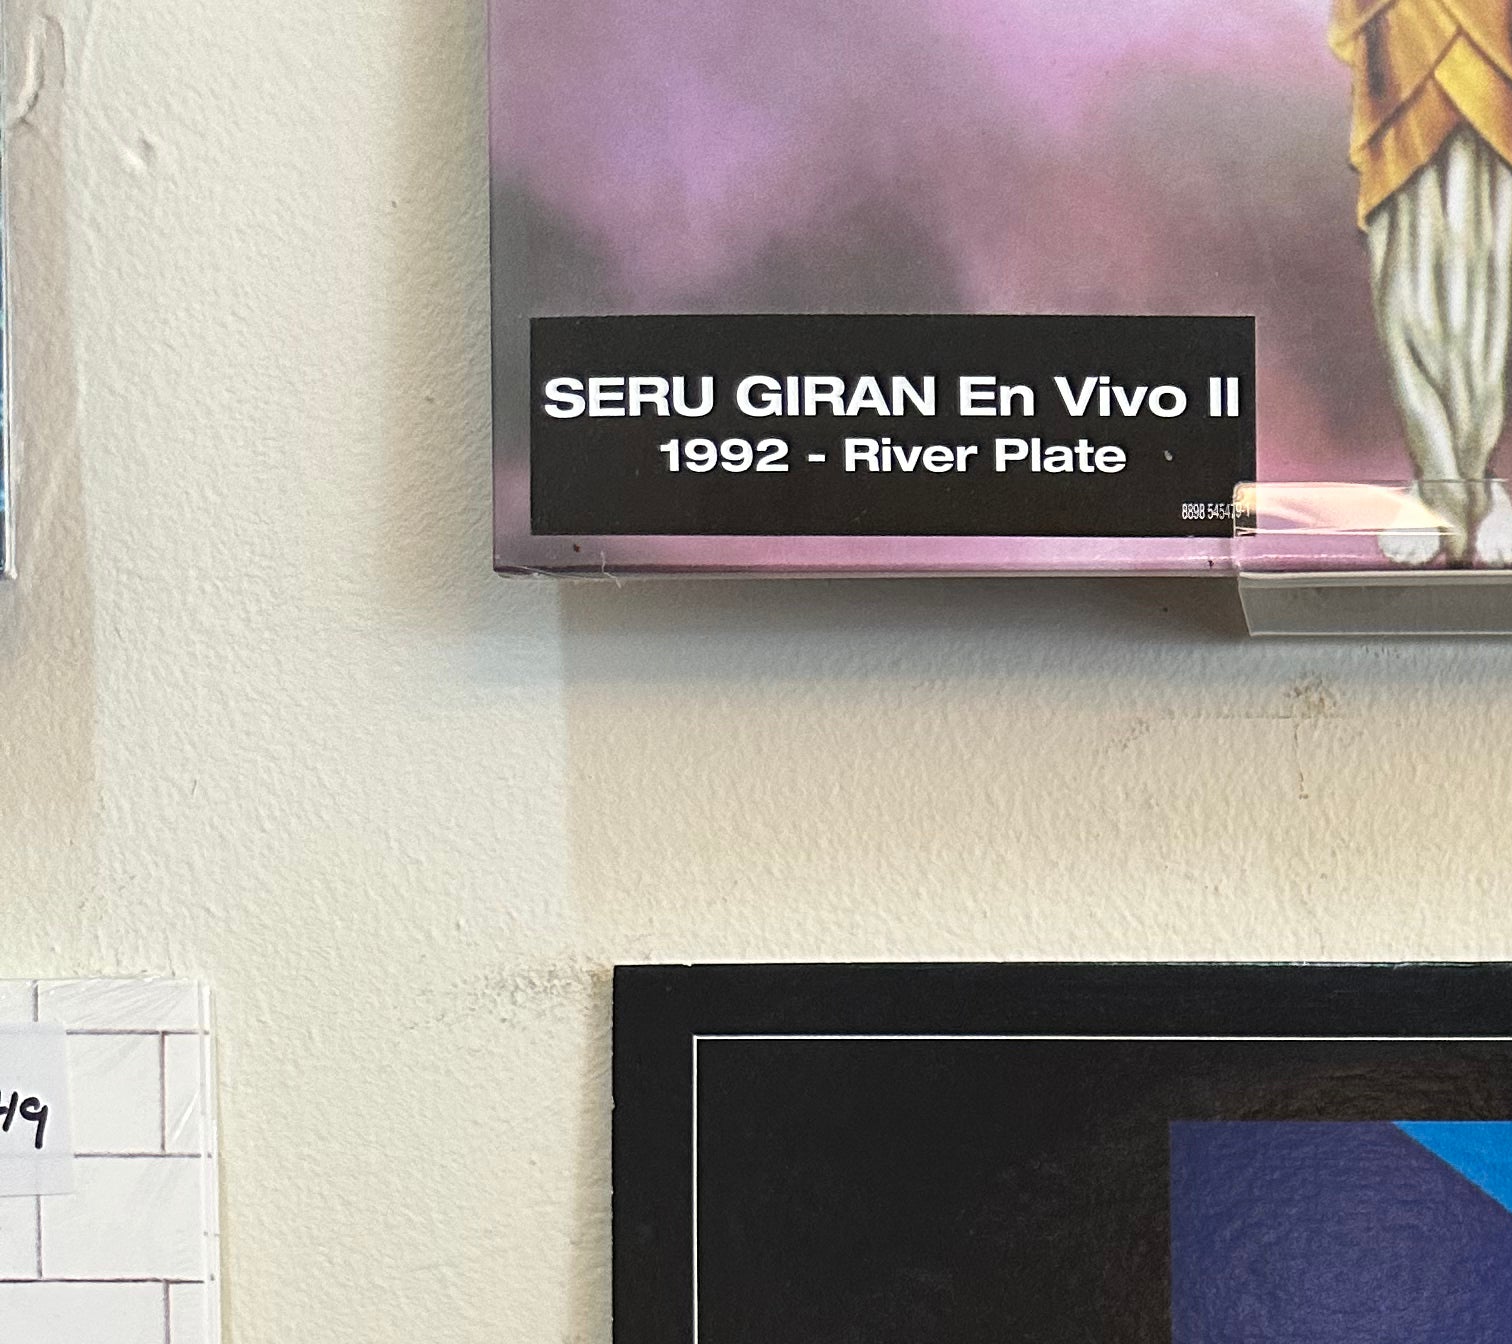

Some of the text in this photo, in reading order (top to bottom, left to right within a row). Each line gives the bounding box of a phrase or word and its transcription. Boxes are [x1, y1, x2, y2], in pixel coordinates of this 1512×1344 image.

[543, 375, 1241, 419] SERU GIRAN En Vivo II
[659, 437, 1128, 473] 1992 - River Plate
